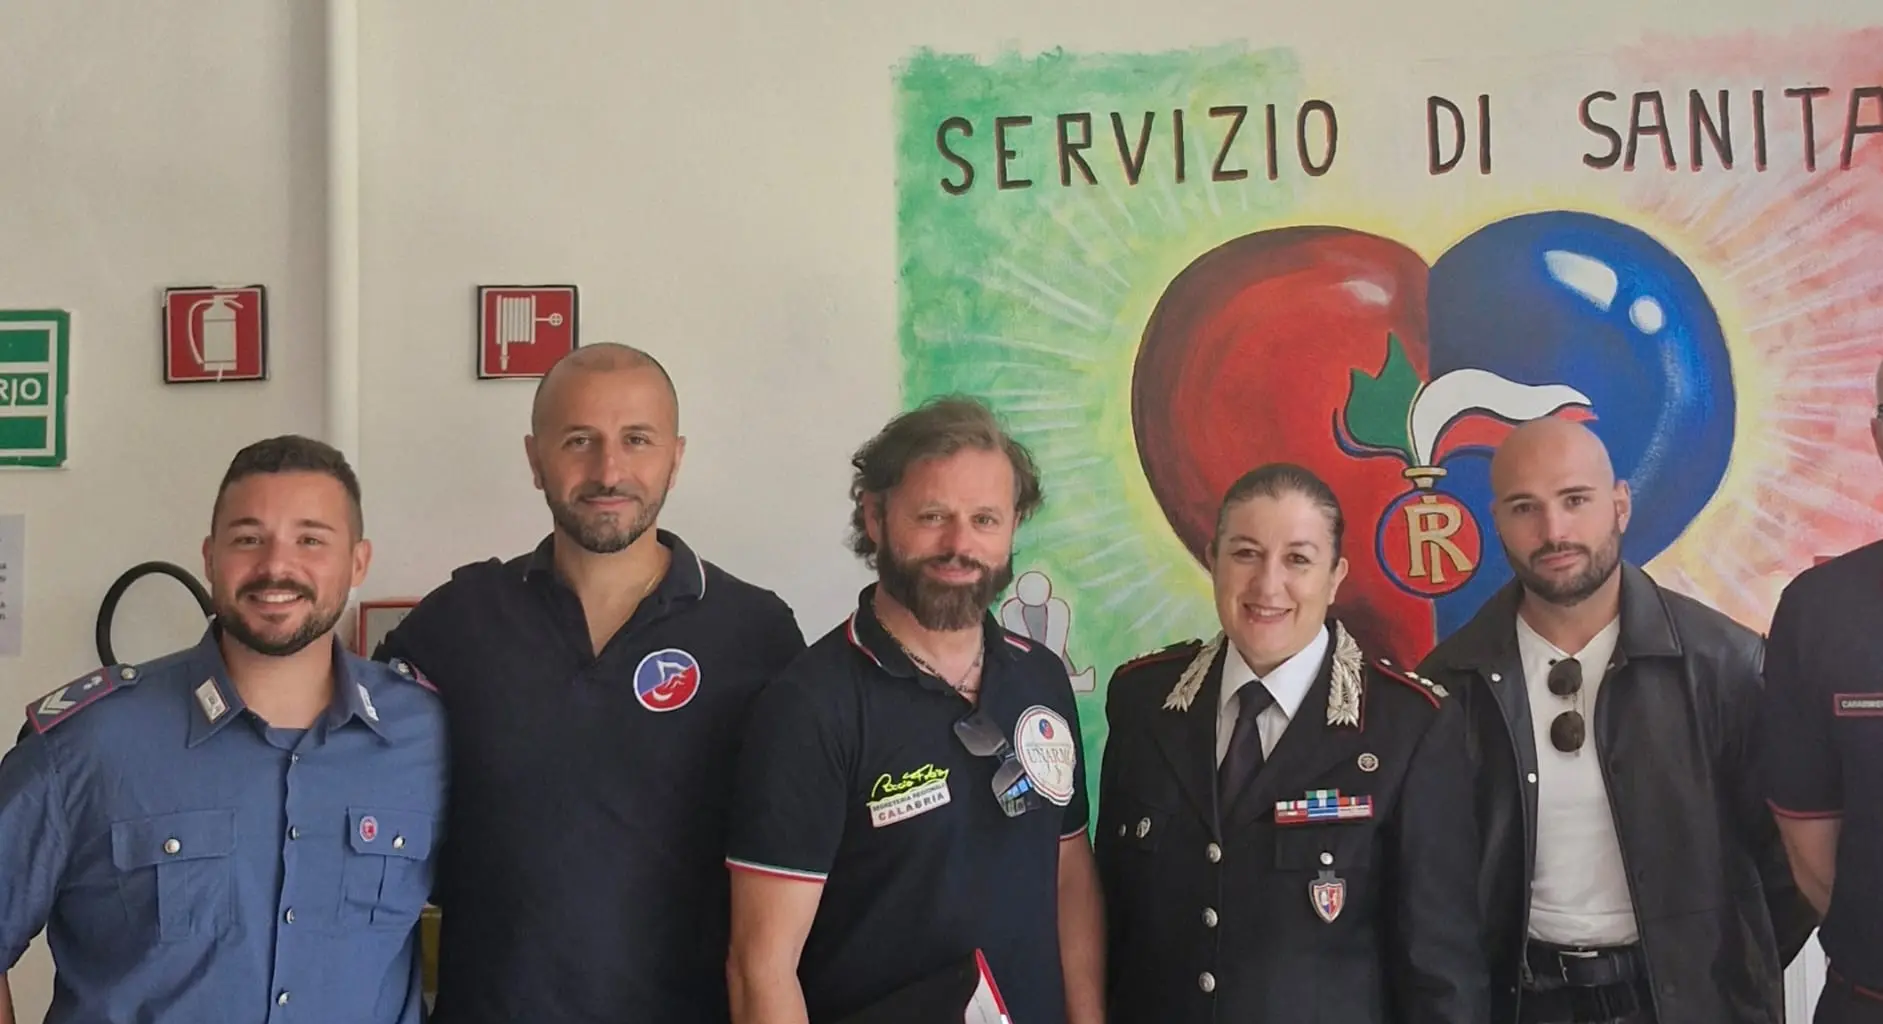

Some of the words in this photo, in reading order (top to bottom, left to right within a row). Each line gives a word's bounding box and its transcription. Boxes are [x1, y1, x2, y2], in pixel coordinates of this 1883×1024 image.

[936, 99, 1338, 196] SERVIZIO
[1427, 94, 1492, 175] DI
[1577, 86, 1883, 173] SANITA
[878, 791, 945, 821] CALABRIA
